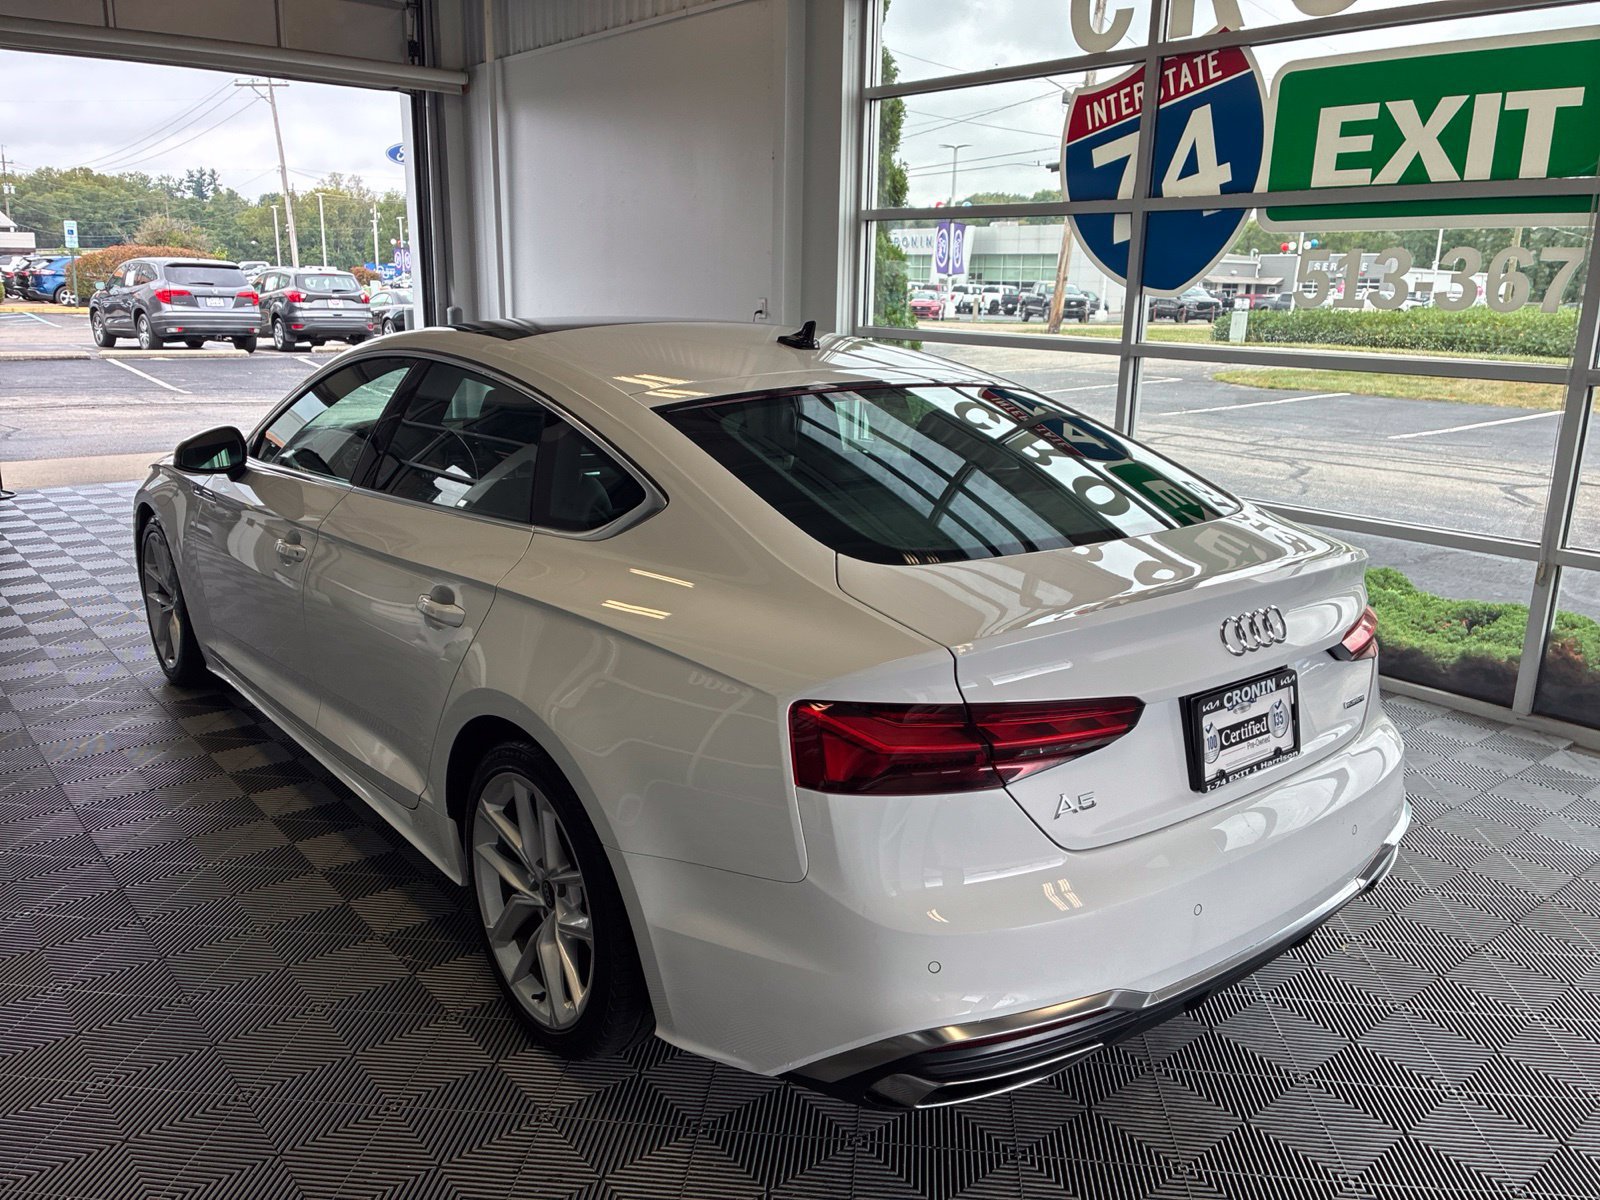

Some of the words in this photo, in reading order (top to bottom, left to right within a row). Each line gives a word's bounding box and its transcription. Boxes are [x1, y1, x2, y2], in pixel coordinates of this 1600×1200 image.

[1085, 50, 1223, 130] INTERTATE
[1311, 87, 1586, 188] EXIT
[1092, 103, 1233, 245] 74
[1292, 246, 1586, 314] 513-367
[1223, 678, 1277, 707] CRONIN
[1221, 717, 1267, 746] Certified
[1273, 710, 1284, 727] 135
[1206, 735, 1218, 751] 100
[1206, 778, 1227, 792] I-74
[1229, 768, 1251, 783] EXIT
[1252, 765, 1259, 775] 1
[1260, 750, 1299, 769] Harrison
[1053, 791, 1097, 820] A5
